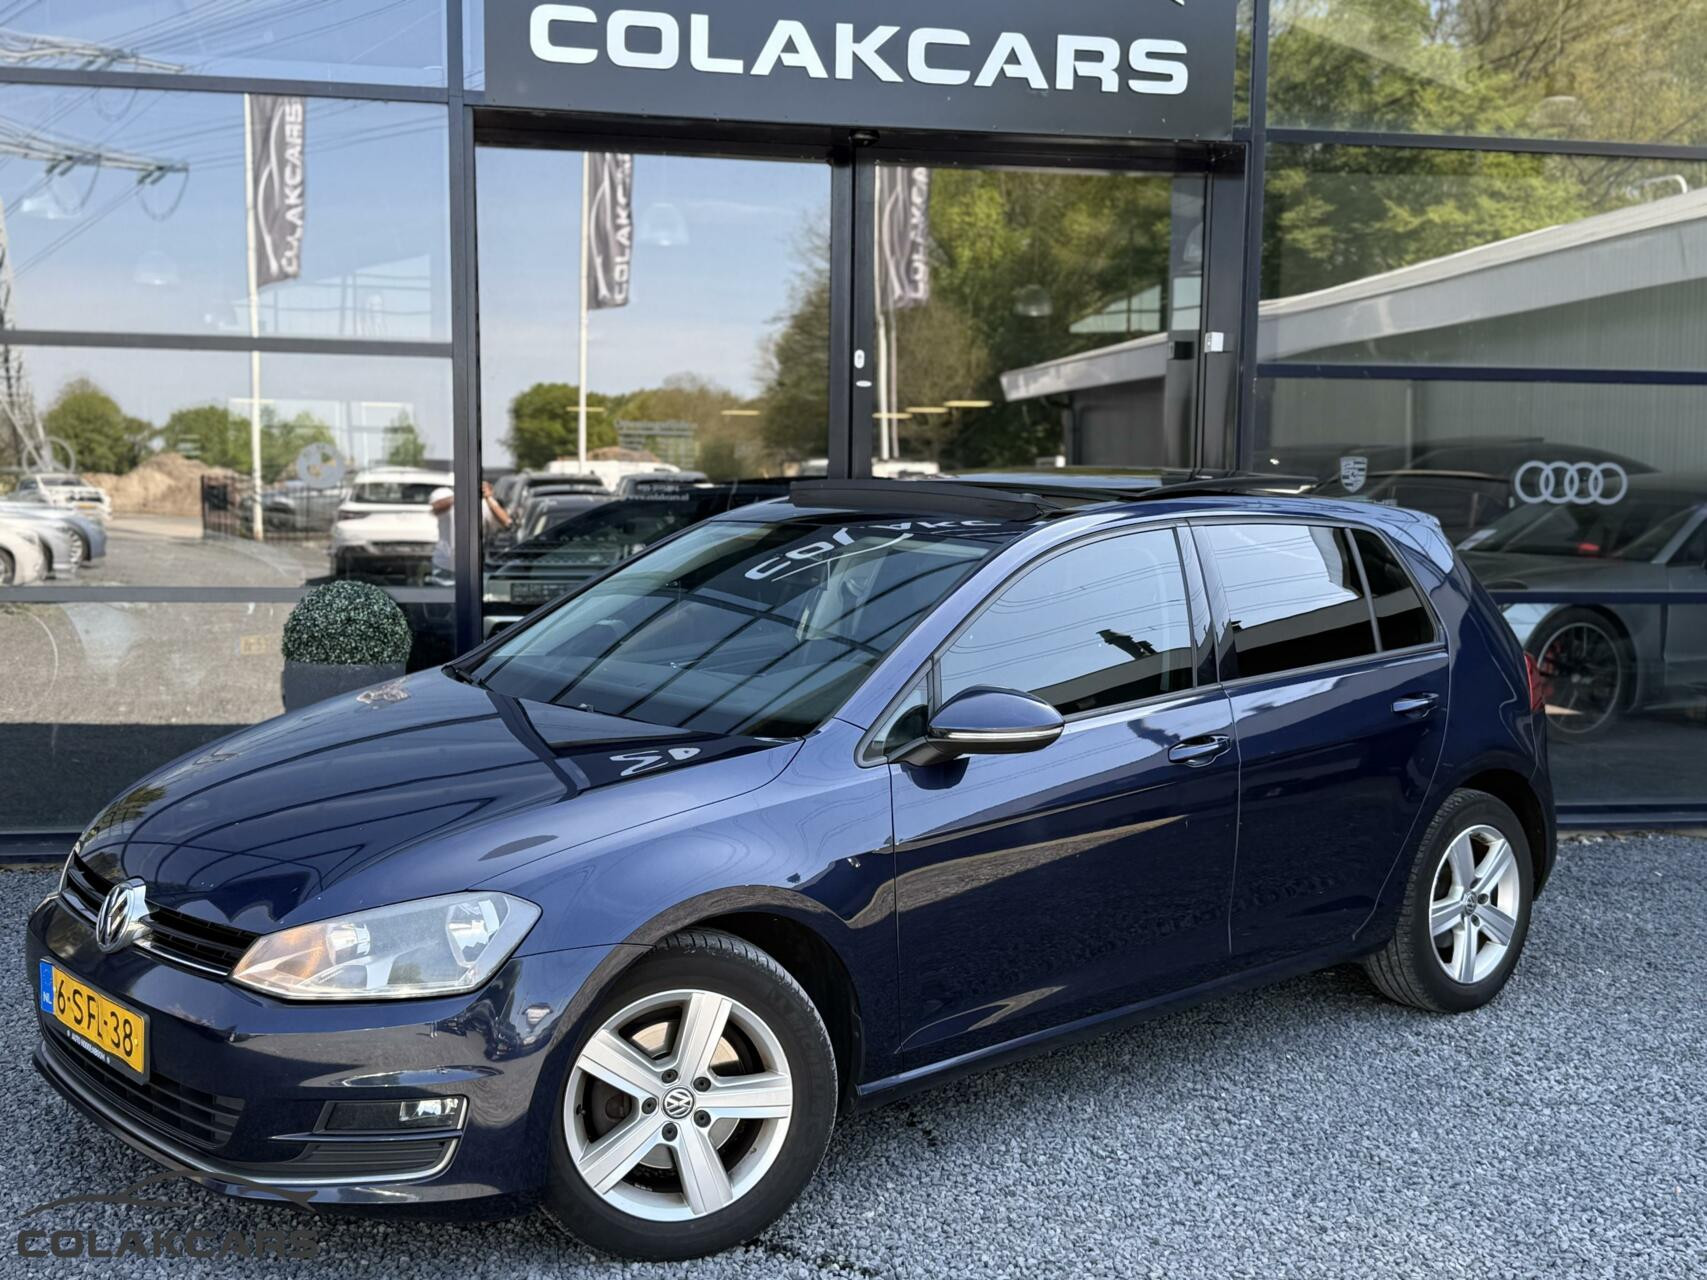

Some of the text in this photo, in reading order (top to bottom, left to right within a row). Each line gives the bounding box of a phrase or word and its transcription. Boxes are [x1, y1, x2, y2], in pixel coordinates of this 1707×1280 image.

[529, 3, 1188, 95] COLAKCARS
[42, 991, 53, 1005] NL
[57, 979, 133, 1057] 6-SFL-38
